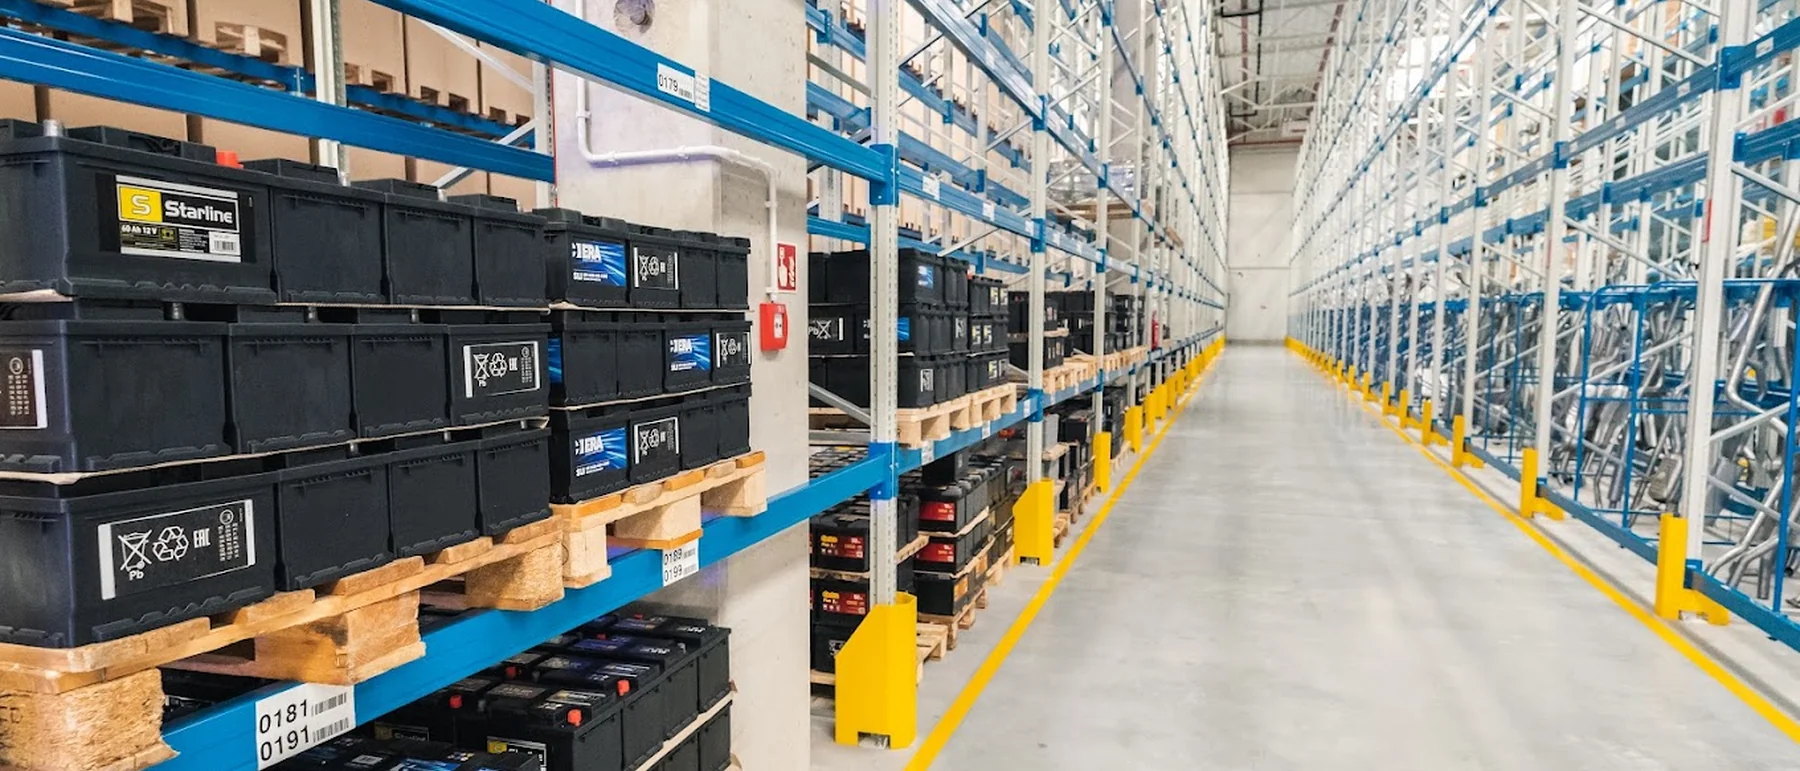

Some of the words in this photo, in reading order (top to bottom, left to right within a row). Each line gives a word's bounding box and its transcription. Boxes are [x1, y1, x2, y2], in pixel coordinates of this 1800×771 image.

[658, 74, 678, 92] 0179
[164, 200, 234, 224] Starline
[142, 226, 151, 235] 12
[151, 227, 158, 235] V
[664, 548, 682, 565] 0189
[129, 570, 145, 581] Pb
[664, 564, 683, 582] 0199
[260, 699, 307, 734] 0181
[260, 725, 310, 762] 0191
